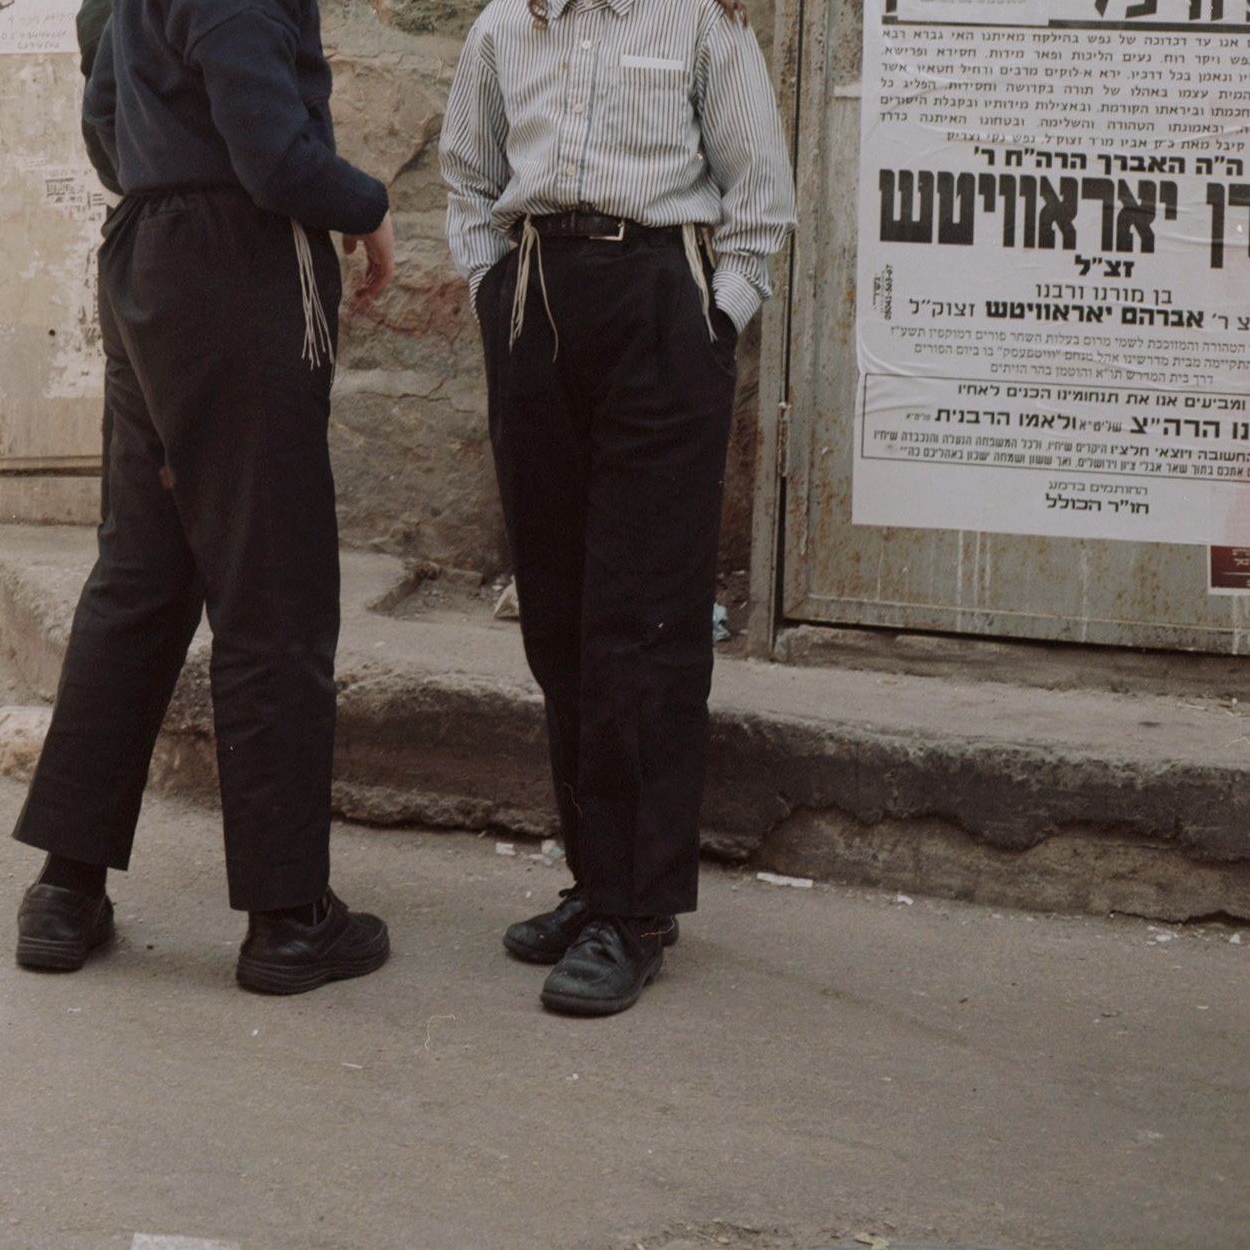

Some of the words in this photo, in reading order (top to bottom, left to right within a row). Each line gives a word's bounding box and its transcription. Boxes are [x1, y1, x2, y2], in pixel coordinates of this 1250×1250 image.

[1004, 147, 1087, 169] הרה"ח
[1097, 150, 1185, 175] האברך
[1197, 155, 1243, 175] ה"ה
[879, 168, 1178, 253] יאראוויטש
[1075, 254, 1135, 278] זצ"ל
[1036, 283, 1084, 299] ורבנו
[1092, 286, 1144, 303] מורנו
[1153, 289, 1173, 306] בן
[909, 298, 976, 318] זצוק"ל
[986, 300, 1112, 324] יאראוויטש
[1121, 306, 1204, 329] אברהם
[959, 385, 1000, 396] לאחיו
[1007, 387, 1051, 399] הכנים
[1058, 390, 1118, 403] תנחומינו
[1126, 394, 1149, 405] את
[1156, 396, 1177, 406] אנו
[1185, 397, 1245, 410] ומביעים
[935, 408, 1010, 426] הרבנית
[1019, 413, 1076, 430] ולאמו
[1130, 416, 1220, 438] הרה"צ
[1090, 482, 1148, 496] החותמים
[1045, 493, 1102, 512] הכולל
